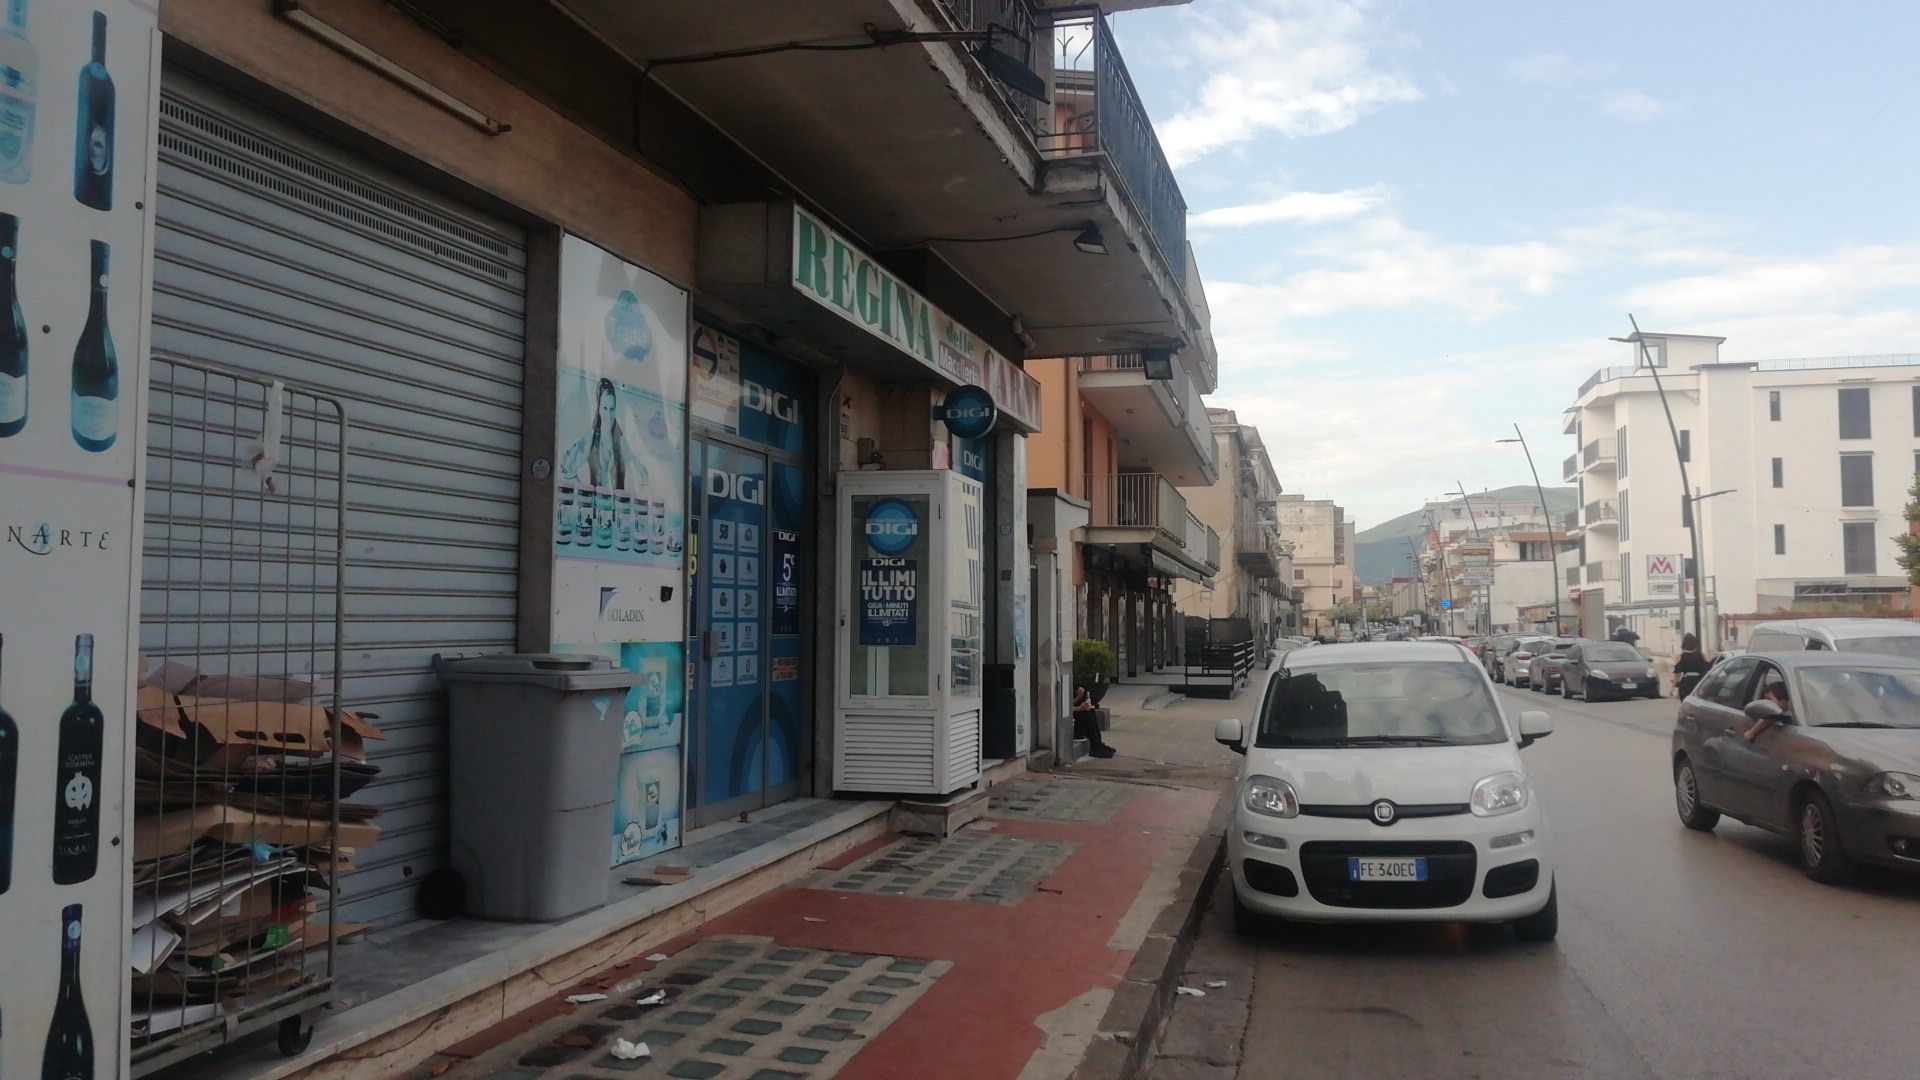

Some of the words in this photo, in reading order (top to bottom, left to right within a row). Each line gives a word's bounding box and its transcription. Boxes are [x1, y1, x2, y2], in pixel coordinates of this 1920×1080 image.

[796, 210, 936, 364] REGINA
[946, 320, 974, 356] delle
[939, 343, 980, 386] Macelleria
[743, 378, 799, 425] DIGI
[946, 407, 989, 419] DIGI
[964, 449, 984, 472] DIGI
[707, 468, 764, 506] DIGI
[778, 531, 796, 542] DIGI
[865, 523, 918, 536] DIGI
[872, 558, 905, 567] DIGI
[861, 570, 916, 586] ILLIMI
[861, 586, 916, 601] TUTTO
[867, 609, 909, 617] ILLIMITATI
